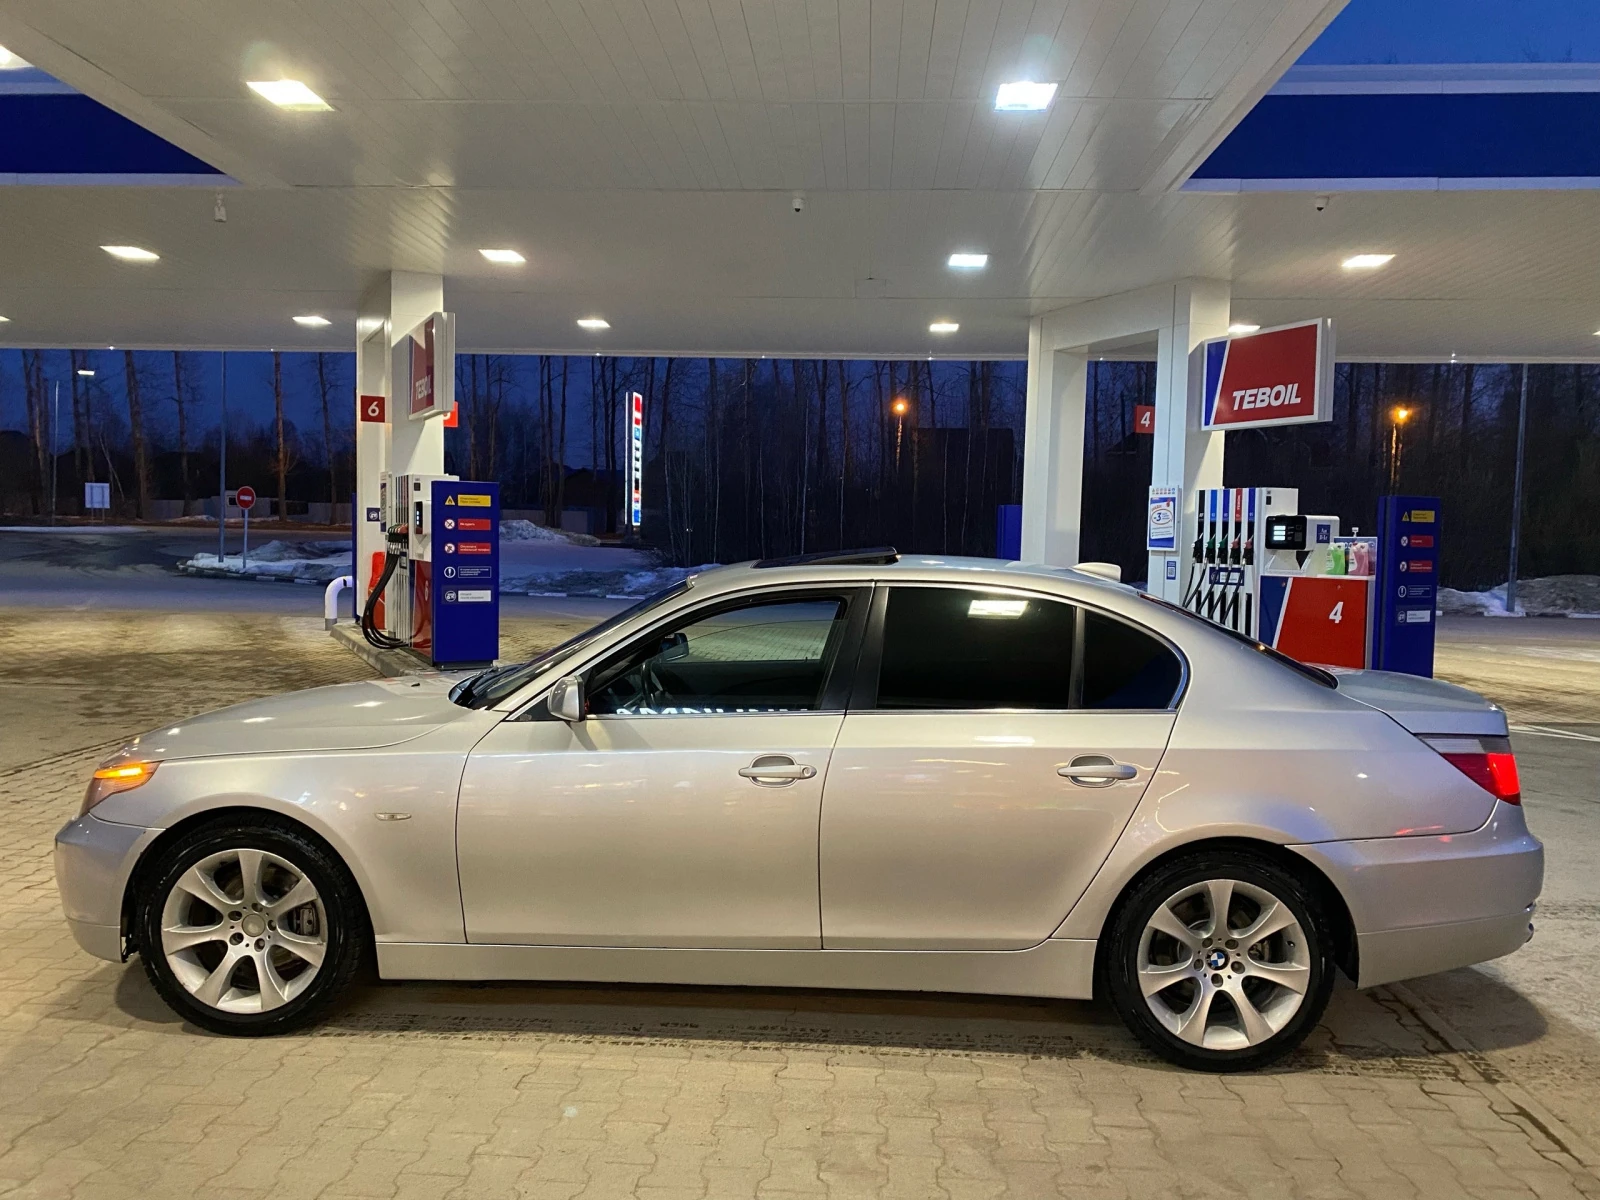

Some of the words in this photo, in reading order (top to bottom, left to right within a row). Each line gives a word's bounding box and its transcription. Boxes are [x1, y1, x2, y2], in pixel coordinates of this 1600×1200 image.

[1232, 382, 1301, 411] TEBOIL
[367, 401, 380, 417] 6
[1140, 411, 1150, 427] 4
[1328, 601, 1343, 624] 4
